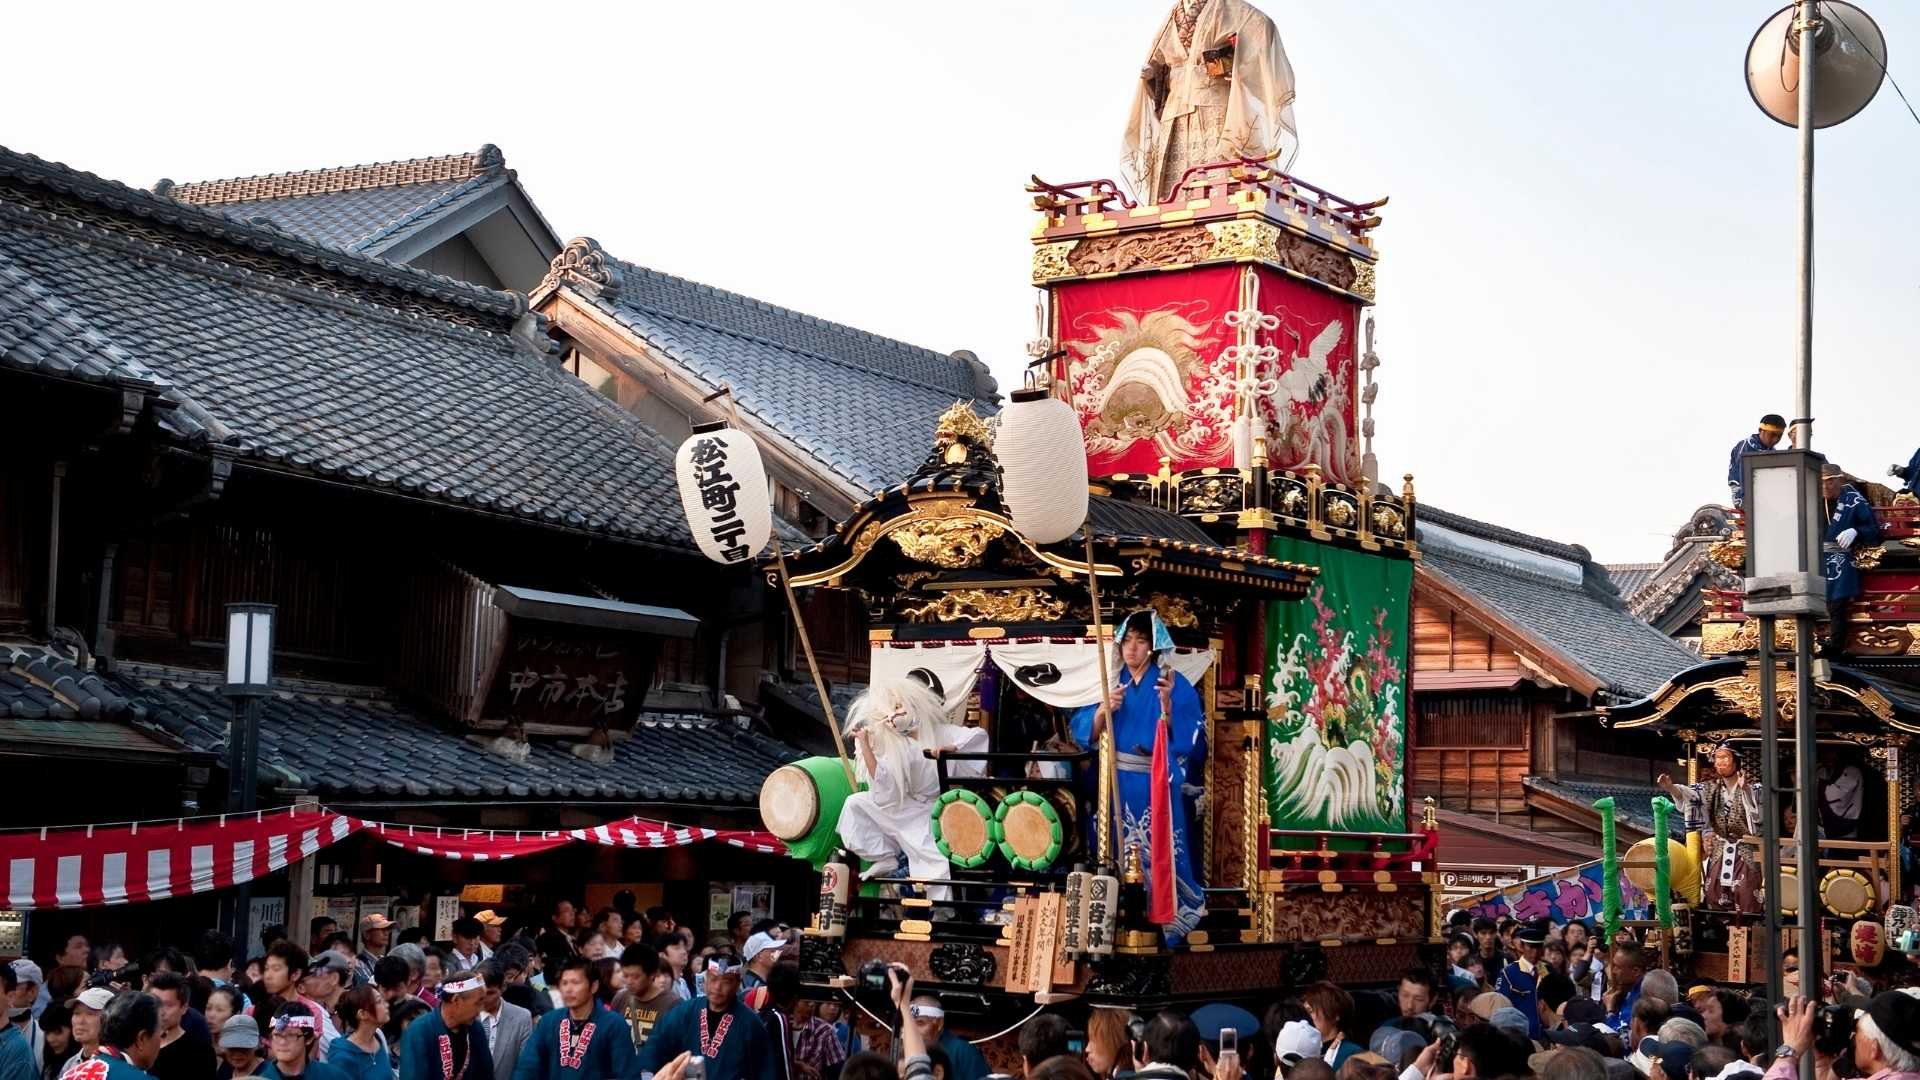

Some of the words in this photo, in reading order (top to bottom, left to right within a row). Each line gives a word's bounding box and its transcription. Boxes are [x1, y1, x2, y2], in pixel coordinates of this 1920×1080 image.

[689, 436, 750, 563] 松江町二丁目
[624, 1007, 659, 1021] PELLON
